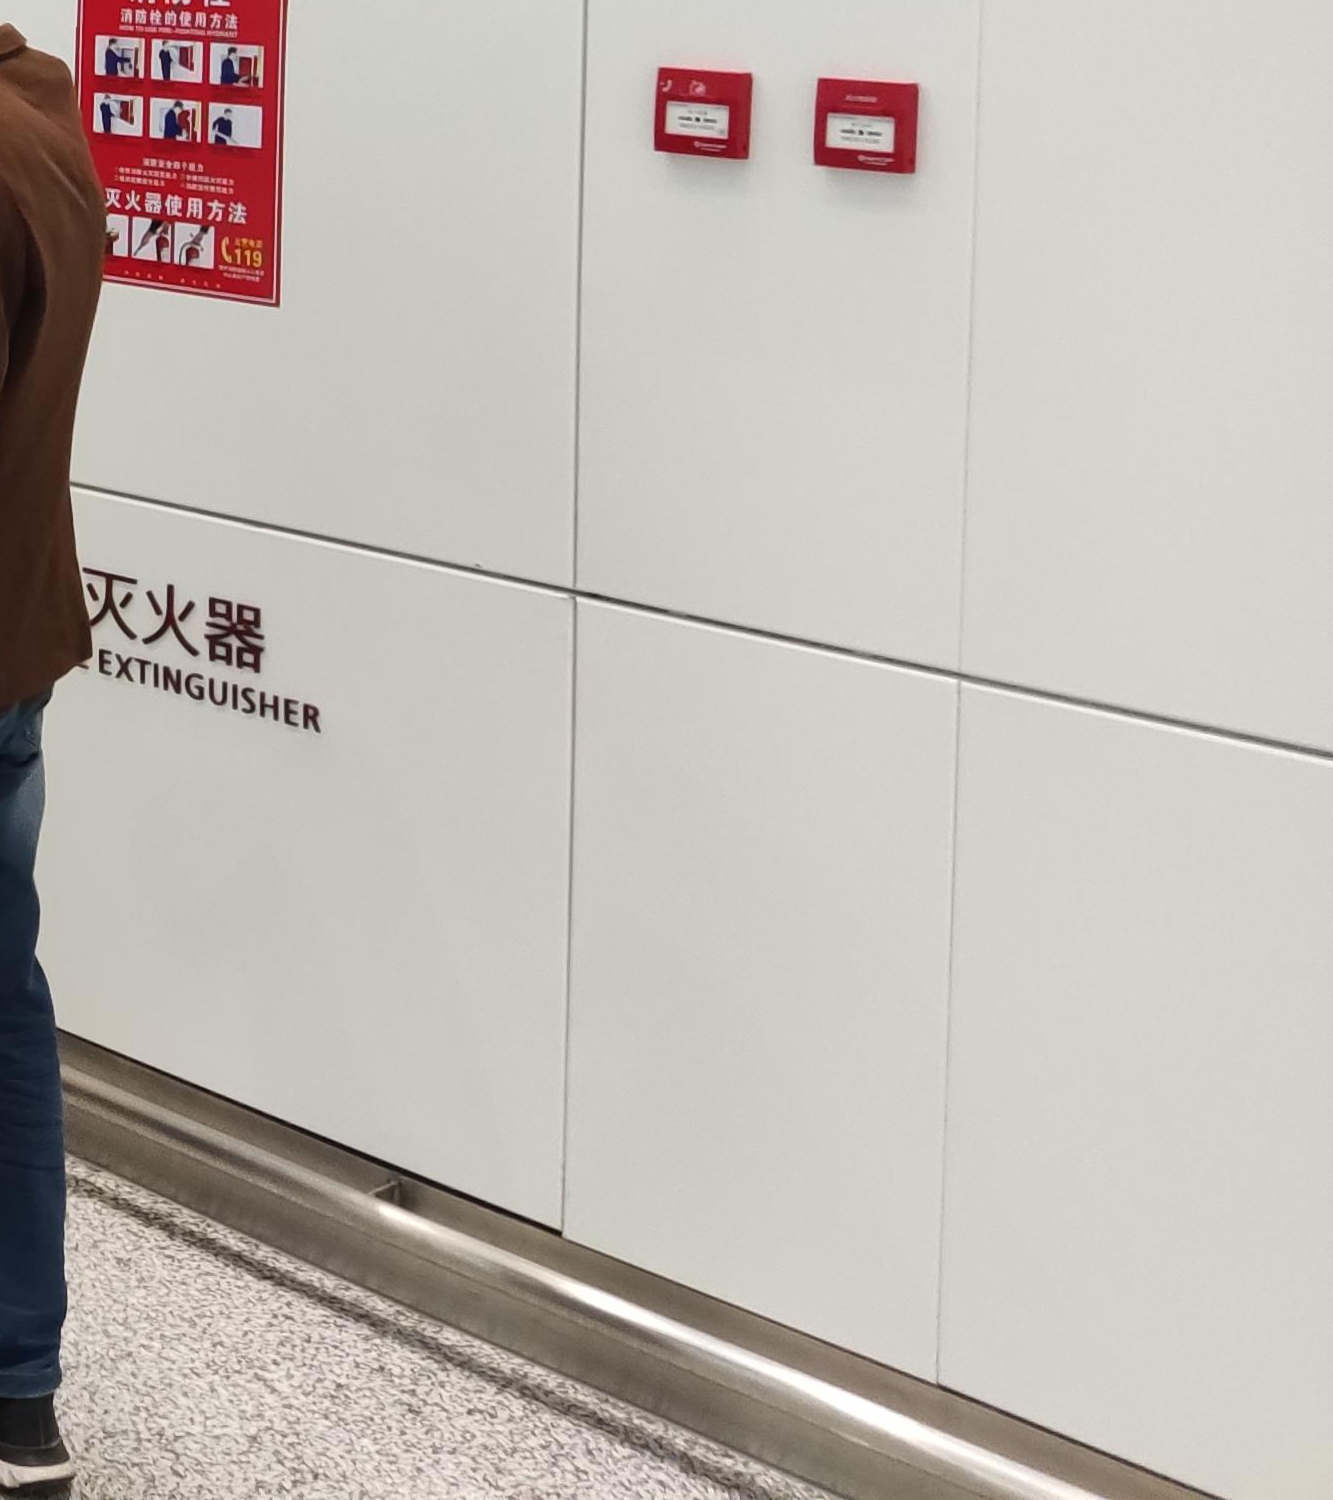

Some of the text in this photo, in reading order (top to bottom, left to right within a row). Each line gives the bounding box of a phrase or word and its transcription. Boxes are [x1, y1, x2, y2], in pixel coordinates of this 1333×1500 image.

[120, 8, 240, 30] 消防栓的使用方法
[105, 188, 248, 225] 灭火器使用方法
[234, 248, 263, 268] 119
[82, 566, 265, 674] 灭火器
[97, 648, 322, 734] EXTINGUISHER
